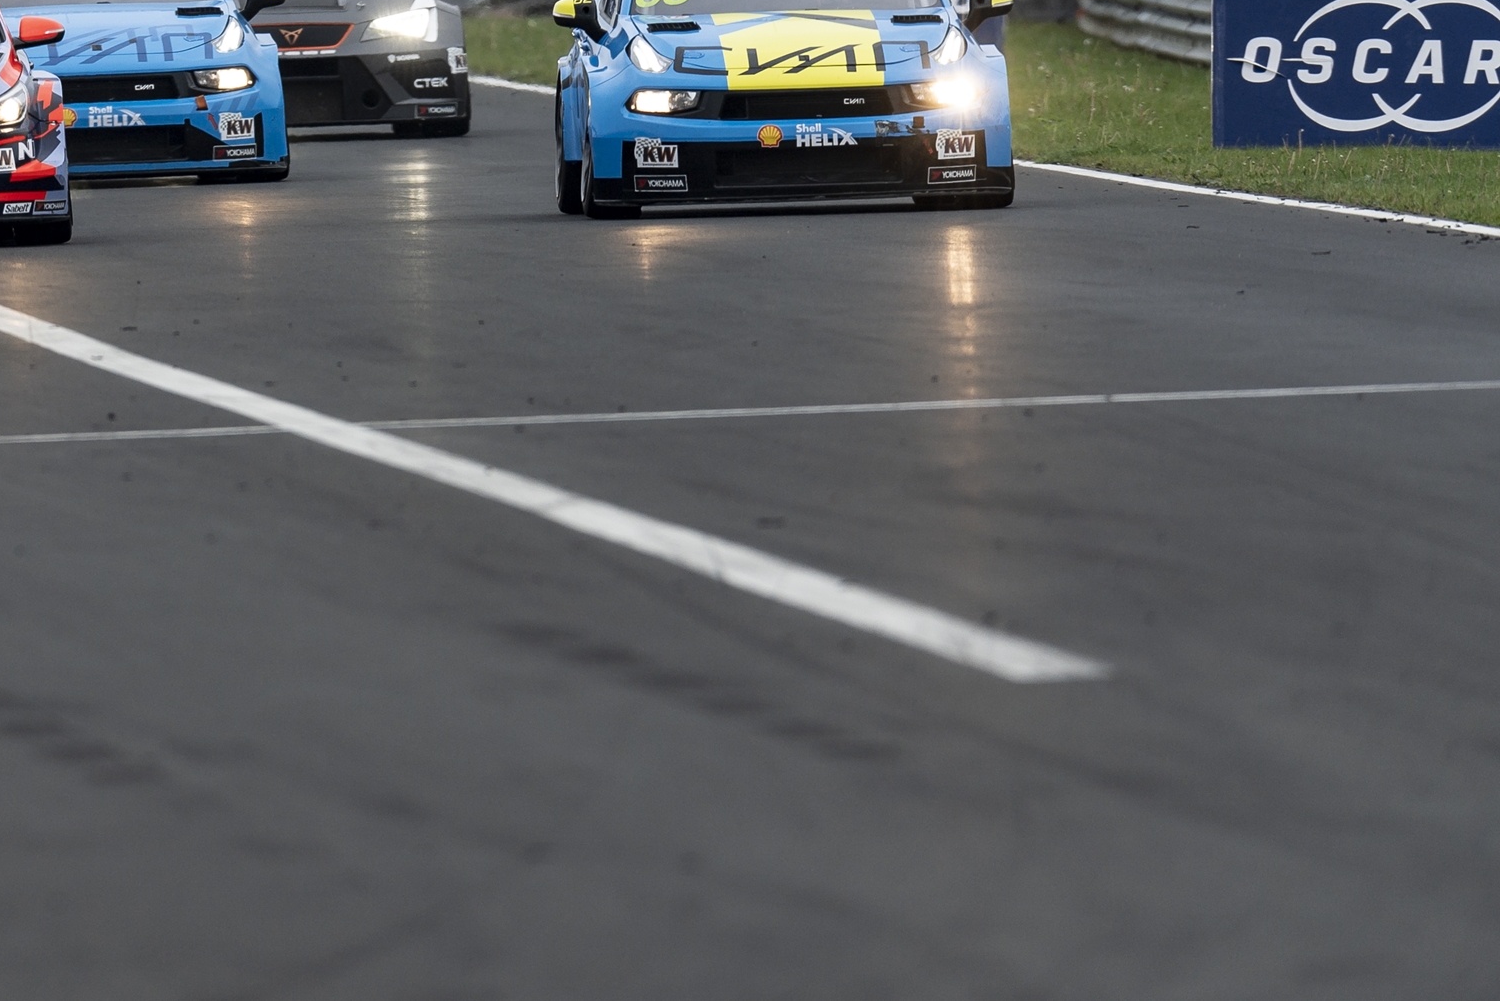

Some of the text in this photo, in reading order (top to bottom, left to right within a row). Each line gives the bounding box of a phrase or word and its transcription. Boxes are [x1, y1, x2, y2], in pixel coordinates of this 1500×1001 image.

[413, 77, 449, 89] CTEK
[88, 106, 112, 115] Shell
[88, 112, 146, 127] HELIX
[226, 119, 253, 136] KW
[796, 123, 822, 134] Shell
[796, 131, 858, 148] HELIX
[944, 137, 974, 154] KW
[226, 149, 255, 157] YOKOHAMA
[643, 146, 677, 162] KW
[942, 169, 974, 179] YOKOHAMA
[4, 203, 30, 214] Sabelt
